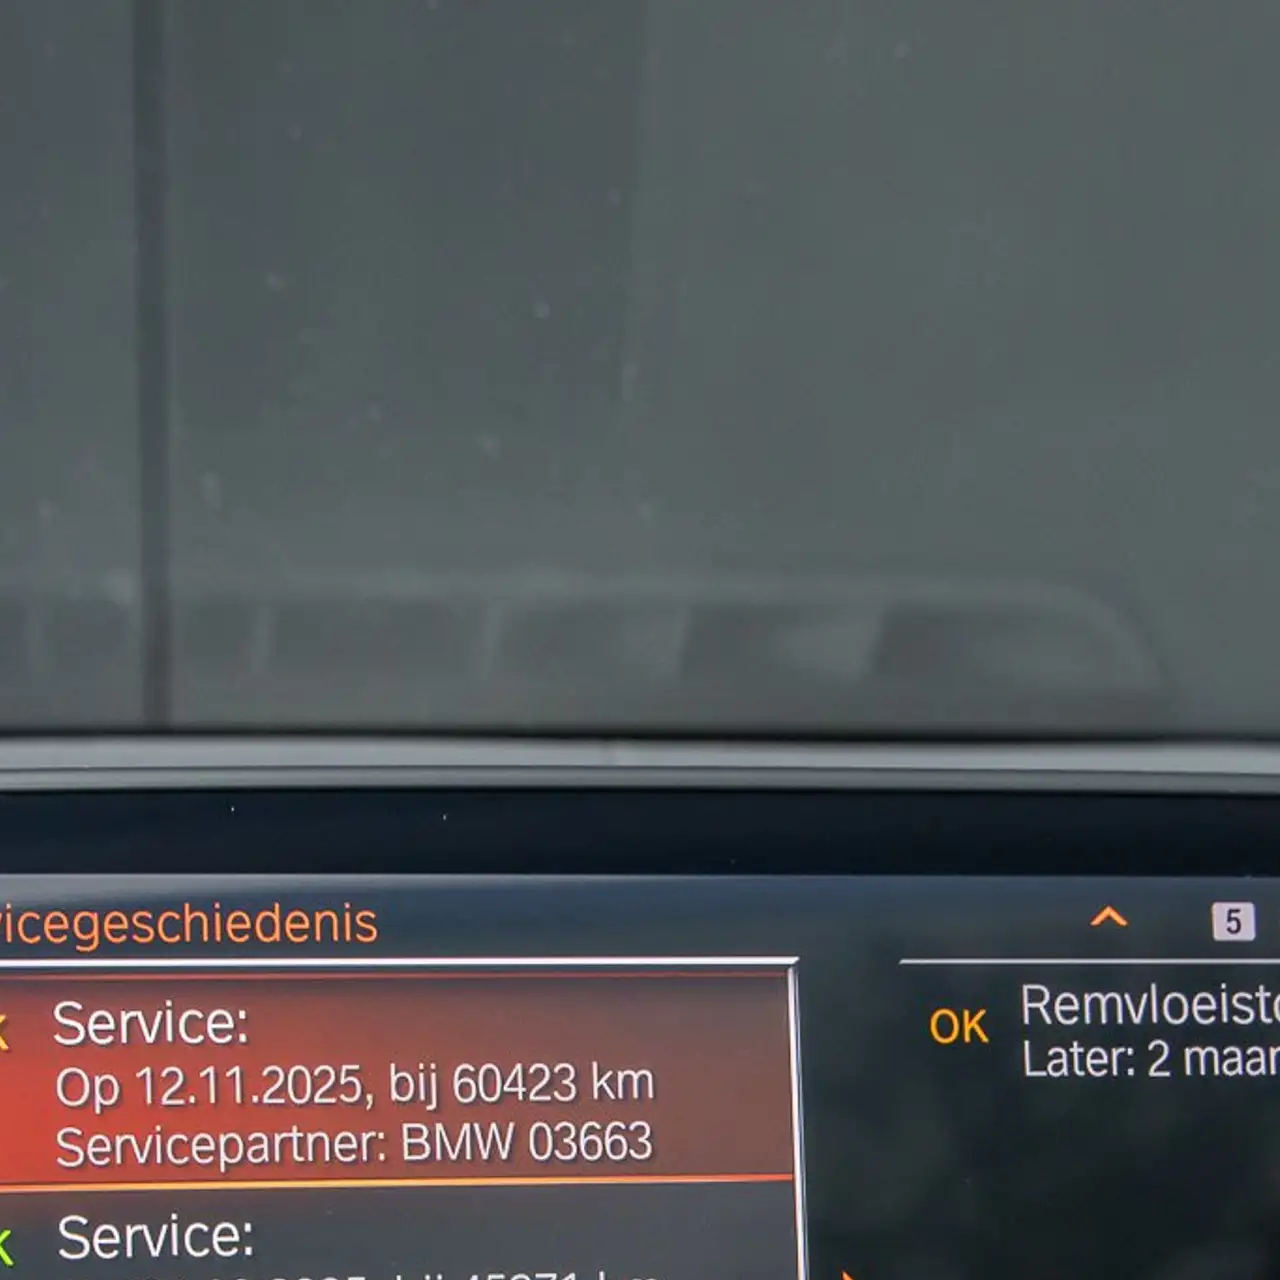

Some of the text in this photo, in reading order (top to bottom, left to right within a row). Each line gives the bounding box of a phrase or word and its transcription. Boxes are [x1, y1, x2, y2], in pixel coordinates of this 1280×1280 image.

[1224, 908, 1242, 936] 5
[53, 999, 247, 1045] Service:
[930, 1008, 989, 1044] OK
[1024, 1039, 1135, 1078] Later:
[1148, 1039, 1171, 1077] 2
[56, 1061, 654, 1115] Op 12.11.2025, bij 60423 km
[56, 1120, 652, 1173] Servicepartner: BMW 03663
[58, 1213, 252, 1260] Service:
